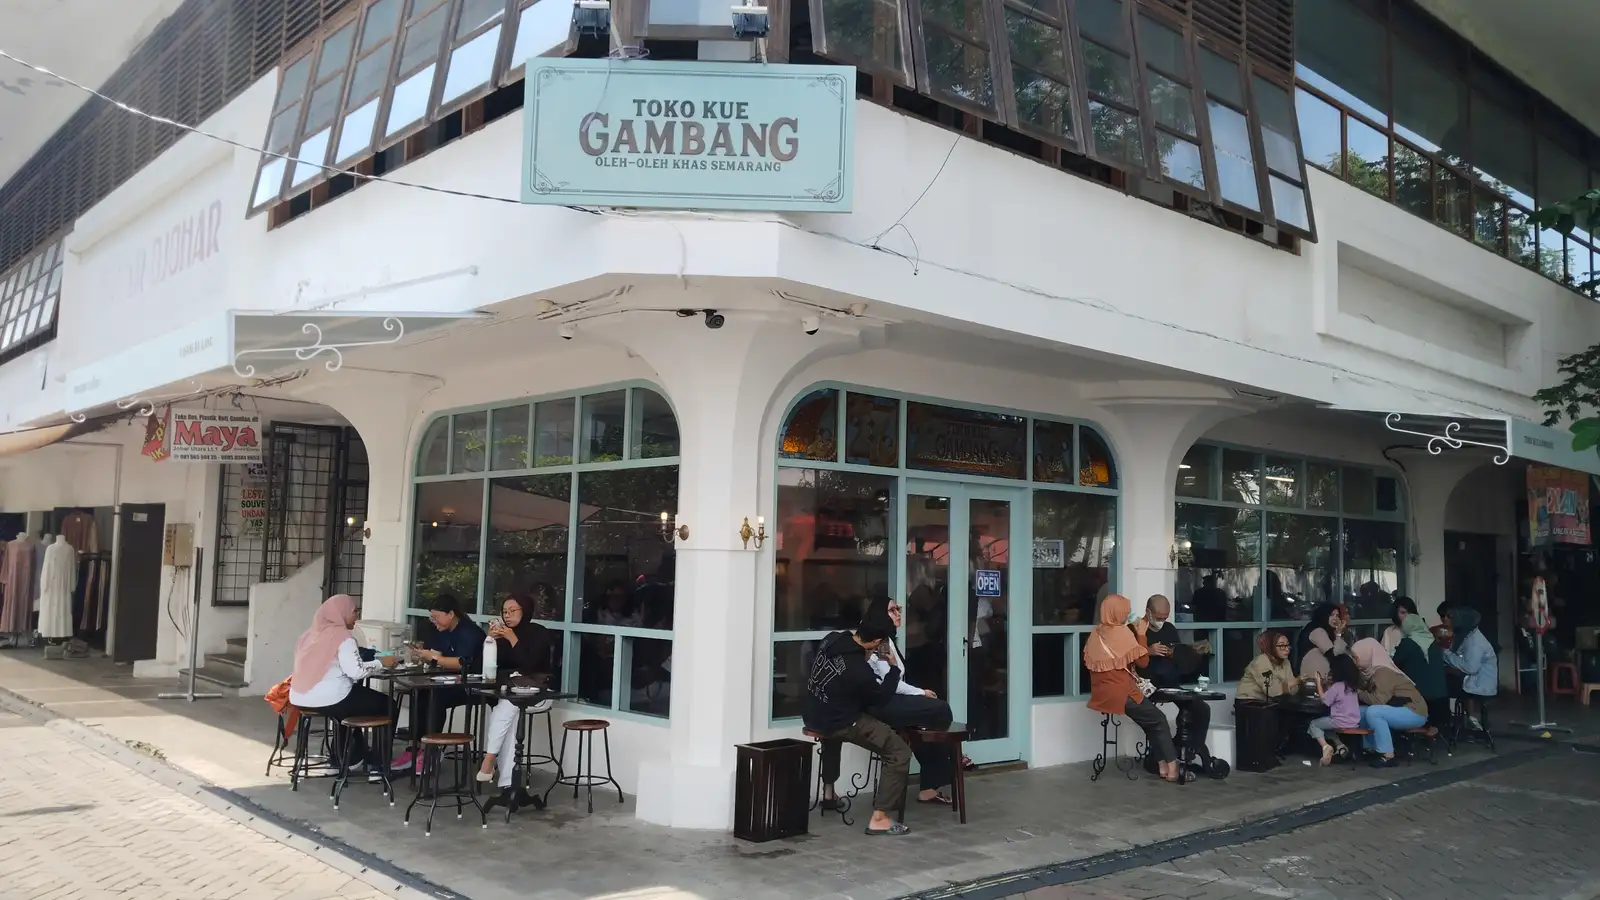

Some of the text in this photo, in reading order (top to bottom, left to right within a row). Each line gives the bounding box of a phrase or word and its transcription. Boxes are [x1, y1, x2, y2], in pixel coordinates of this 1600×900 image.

[632, 98, 749, 120] TOKO KUE
[579, 111, 799, 161] GAMBANG
[594, 155, 782, 173] OLEH-OLEH KHAS SEMARANG
[173, 420, 259, 452] Maya
[977, 576, 999, 591] OPEN
